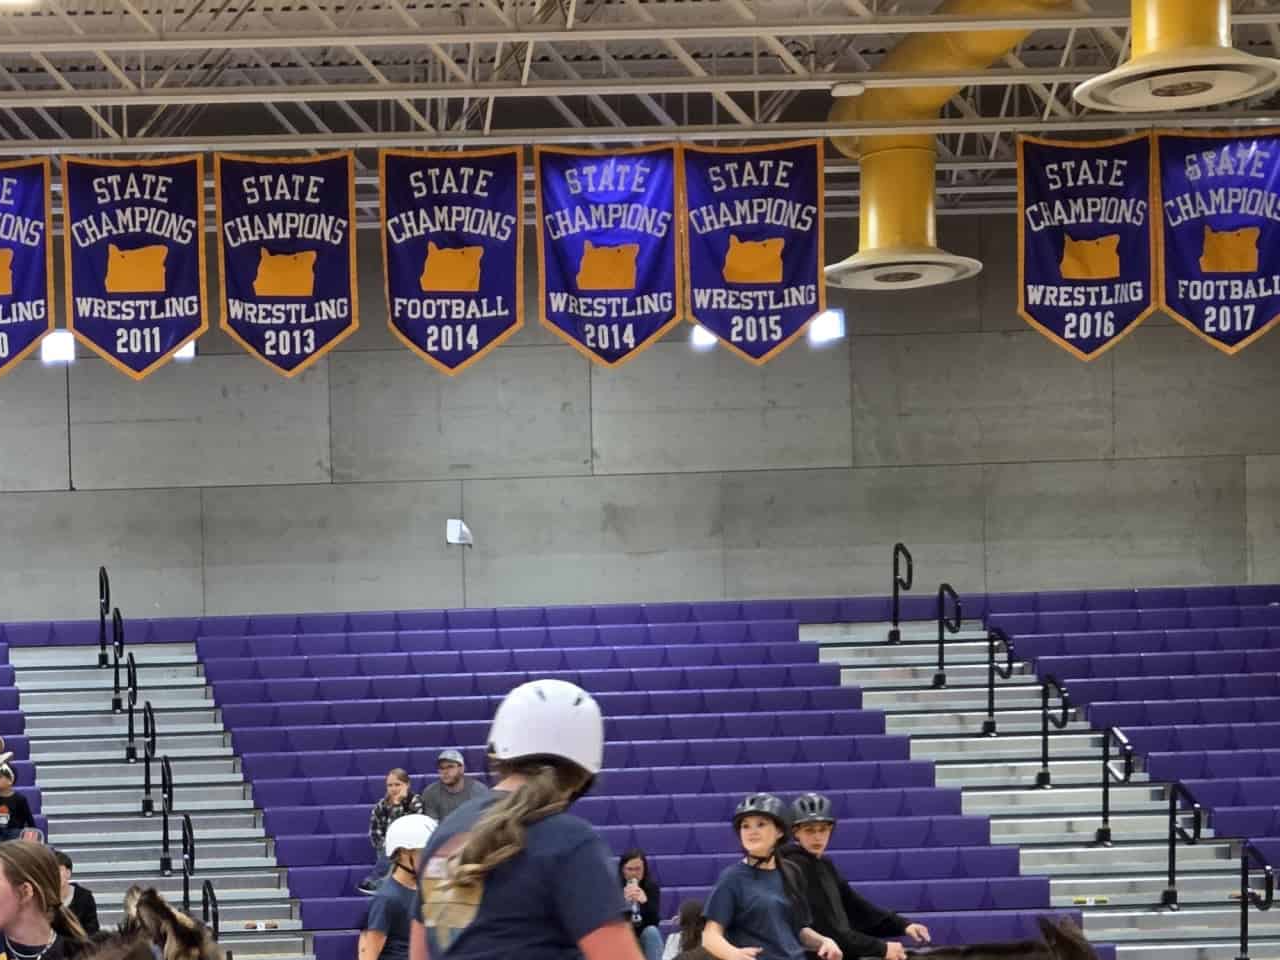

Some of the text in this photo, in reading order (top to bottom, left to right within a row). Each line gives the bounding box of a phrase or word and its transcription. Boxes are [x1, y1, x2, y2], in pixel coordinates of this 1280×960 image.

[93, 173, 172, 204] STATE
[409, 167, 494, 198] STATE
[565, 162, 651, 194] STATE
[708, 160, 794, 193] STATE
[1045, 159, 1128, 190] STATE
[242, 174, 324, 204] STATE
[72, 207, 196, 248] CHAMPIONS
[386, 205, 517, 244] CHAMPIONS
[544, 203, 673, 240] CHAMPIONS
[689, 199, 817, 235] CHAMPIONS
[1025, 197, 1147, 232] CHAMPIONS
[224, 213, 347, 248] CHAMPIONS
[75, 296, 198, 320] WRESTLING
[394, 296, 509, 319] FOOTBALL
[549, 292, 673, 317] WRESTLING
[693, 285, 817, 311] WRESTLING
[1027, 281, 1143, 307] WRESTLING
[228, 299, 348, 324] WRESTLING
[1064, 311, 1115, 339] 2016
[1204, 304, 1256, 332] 2017
[116, 327, 161, 353] 2011
[264, 329, 315, 355] 2013
[426, 325, 478, 351] 2014
[584, 324, 635, 349] 2014
[730, 316, 783, 342] 2015
